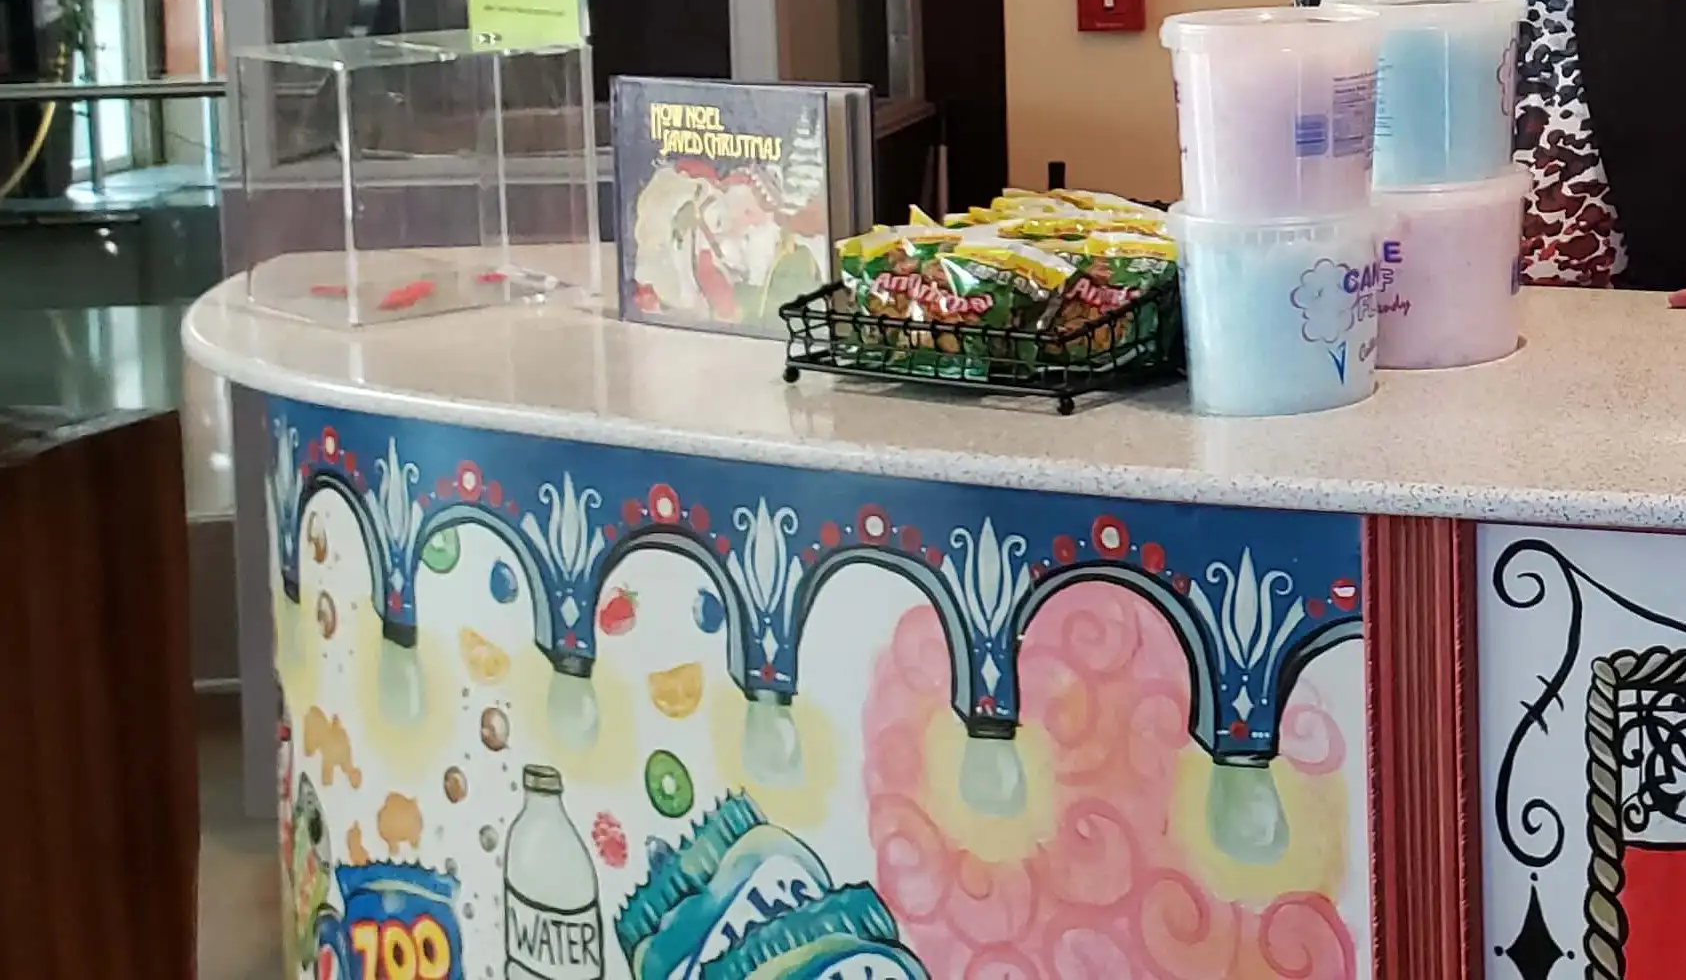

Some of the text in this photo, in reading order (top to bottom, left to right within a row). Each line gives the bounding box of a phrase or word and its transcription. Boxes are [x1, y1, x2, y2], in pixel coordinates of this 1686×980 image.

[685, 105, 725, 130] NOEL
[704, 133, 783, 161] CHRISTMAS
[508, 904, 599, 966] WATER
